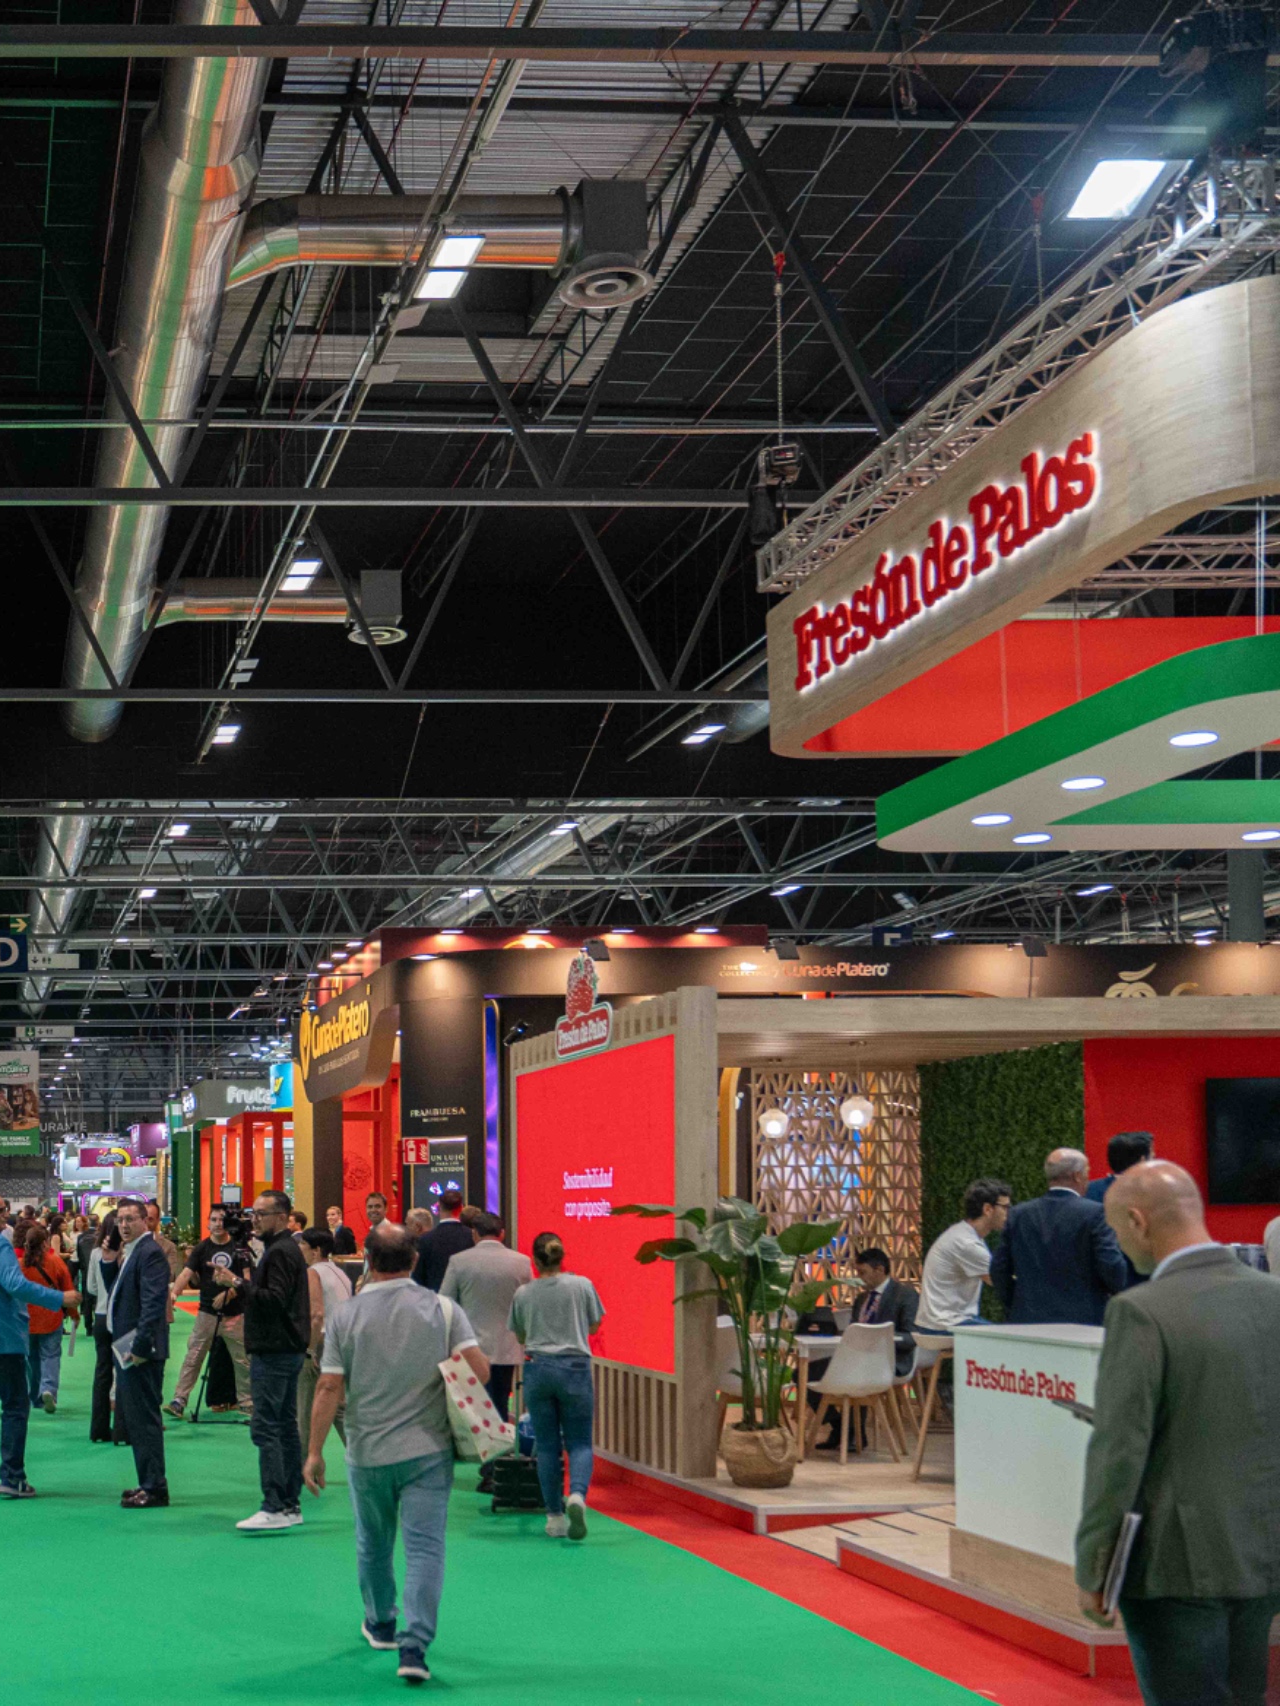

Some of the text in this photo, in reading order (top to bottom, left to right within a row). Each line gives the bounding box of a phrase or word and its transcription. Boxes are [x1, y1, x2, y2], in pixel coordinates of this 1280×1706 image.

[793, 432, 1097, 692] Fresón de Palos
[410, 1106, 466, 1118] FRAMBUESA
[966, 1359, 1076, 1402] Fresón de Palos
